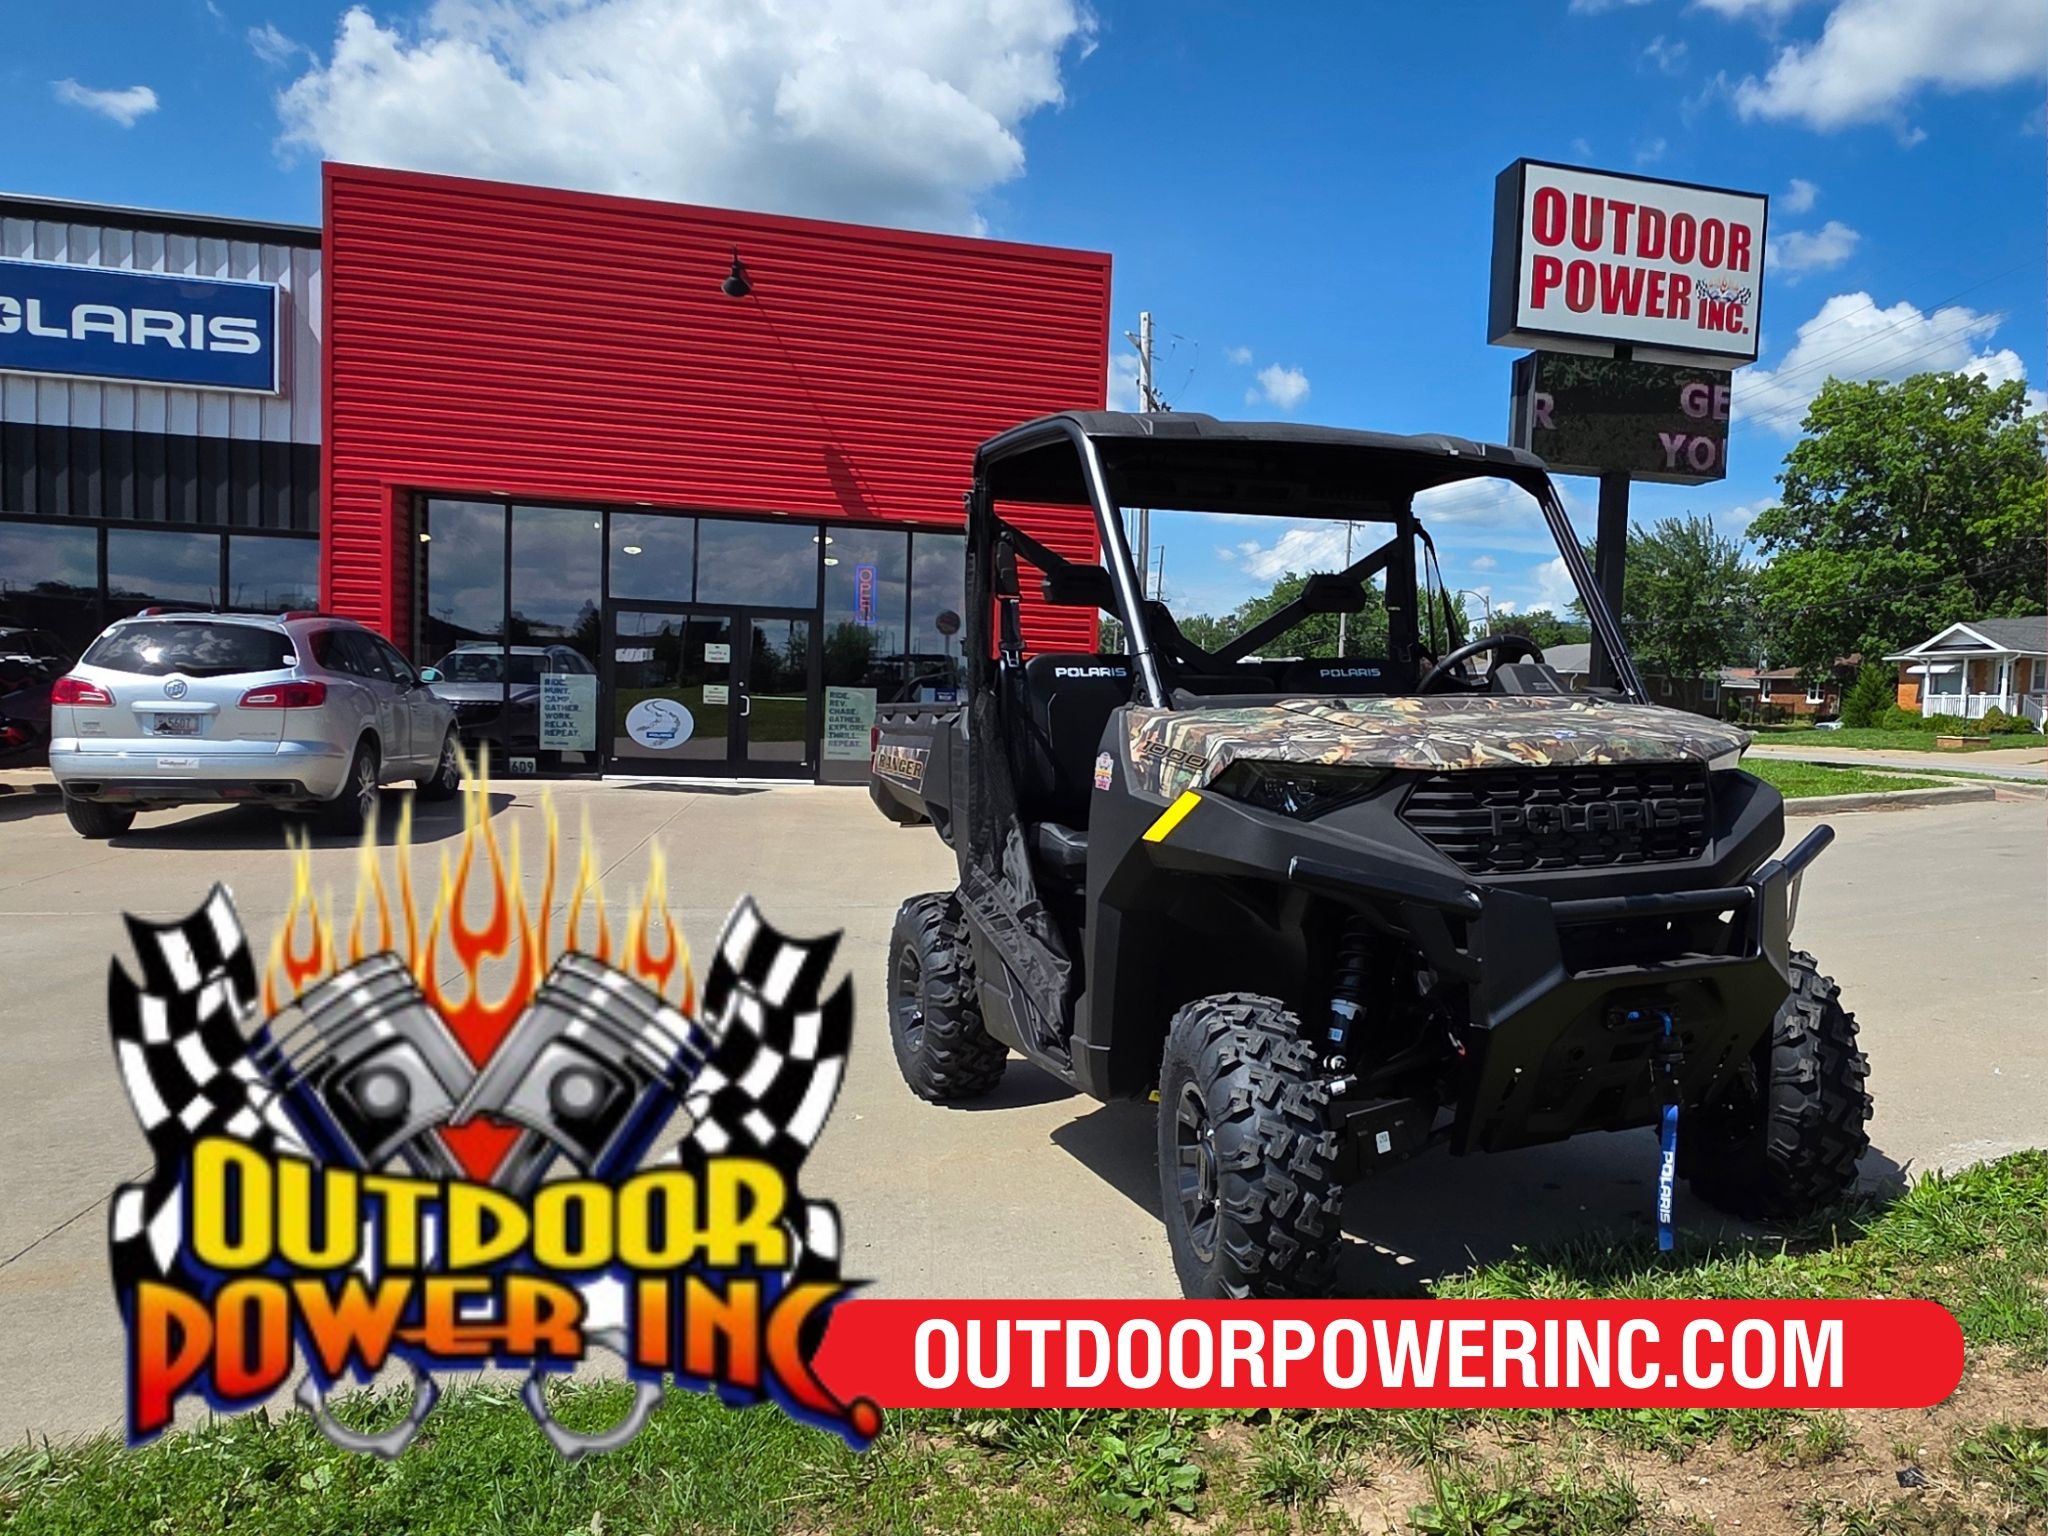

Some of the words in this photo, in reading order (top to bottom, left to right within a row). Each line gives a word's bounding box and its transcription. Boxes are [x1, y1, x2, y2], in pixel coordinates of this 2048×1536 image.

[1532, 186, 1752, 273] OUTDOOR
[1530, 254, 1692, 320] POWER
[1697, 301, 1749, 334] INC.
[1659, 432, 1727, 470] YO
[1055, 666, 1126, 678] POLARIS
[1319, 667, 1381, 678] POLARIS
[544, 687, 570, 695] HUNT.
[829, 692, 850, 700] RIDE.
[544, 704, 581, 712] GATHER.
[544, 712, 572, 720] WORK.
[544, 721, 576, 729] RELAX.
[544, 729, 580, 737] REPEAT.
[1143, 741, 1207, 770] 1000
[512, 761, 534, 772] 609
[878, 754, 923, 778] RANGER
[1491, 798, 1682, 836] POLARIS
[1660, 1150, 1674, 1224] POLARIS
